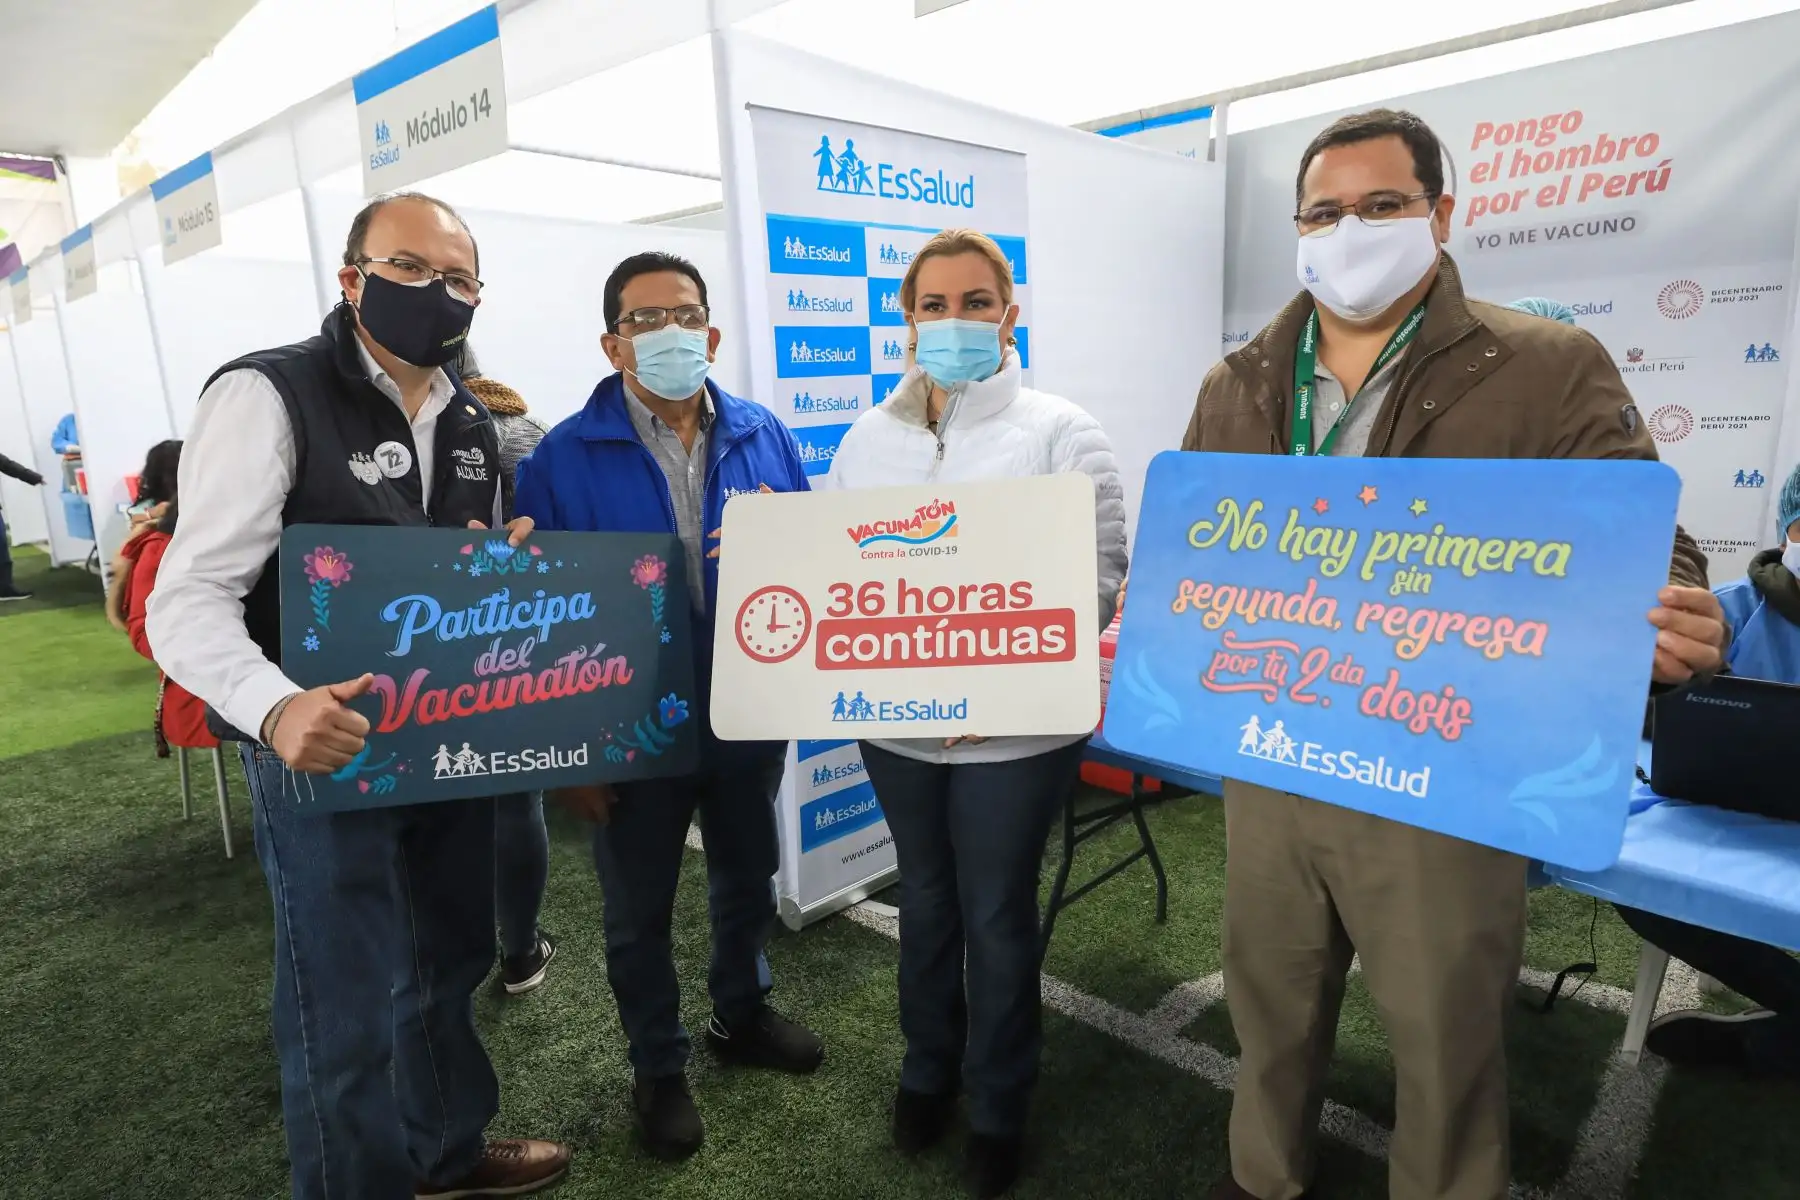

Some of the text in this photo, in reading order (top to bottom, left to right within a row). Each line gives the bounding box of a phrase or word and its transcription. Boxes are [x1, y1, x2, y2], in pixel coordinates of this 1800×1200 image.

[406, 87, 492, 148] Módulo 14
[1470, 110, 1584, 151] Pongo
[369, 144, 400, 170] EsSalud
[1469, 132, 1661, 184] el hombro
[877, 162, 974, 209] EsSalud
[1464, 158, 1675, 227] por el Perú
[1475, 216, 1637, 250] YO ME VACUNO
[808, 244, 851, 263] EsSalud
[811, 297, 853, 313] EsSalud
[1711, 285, 1783, 296] BICENTENARIO
[1738, 294, 1760, 302] 2021
[1571, 300, 1613, 316] Salud
[1221, 330, 1249, 344] Salud
[813, 346, 856, 363] EsSalud
[1638, 362, 1656, 372] del
[1659, 360, 1685, 372] Perú
[816, 395, 859, 412] EsSalud
[847, 498, 957, 544] VACUNATÓN
[861, 545, 958, 560] Contra la COVID-19
[1188, 497, 1572, 581] No hay primera
[1389, 564, 1432, 597] sin
[826, 577, 1034, 618] 36 horas
[380, 587, 597, 657] Participa
[1171, 577, 1550, 660] segunda, regresa
[474, 636, 537, 677] del
[825, 618, 1067, 663] contínuas
[368, 642, 634, 733] Vacunatón
[1207, 650, 1259, 681] por
[1360, 668, 1474, 741] dosis
[1685, 692, 1752, 709] lenovo
[879, 697, 968, 722] EsSalud
[490, 742, 589, 775] EsSalud
[834, 759, 866, 780] EsSal
[1300, 740, 1431, 799] EsSalud
[836, 795, 877, 822] EsSalud
